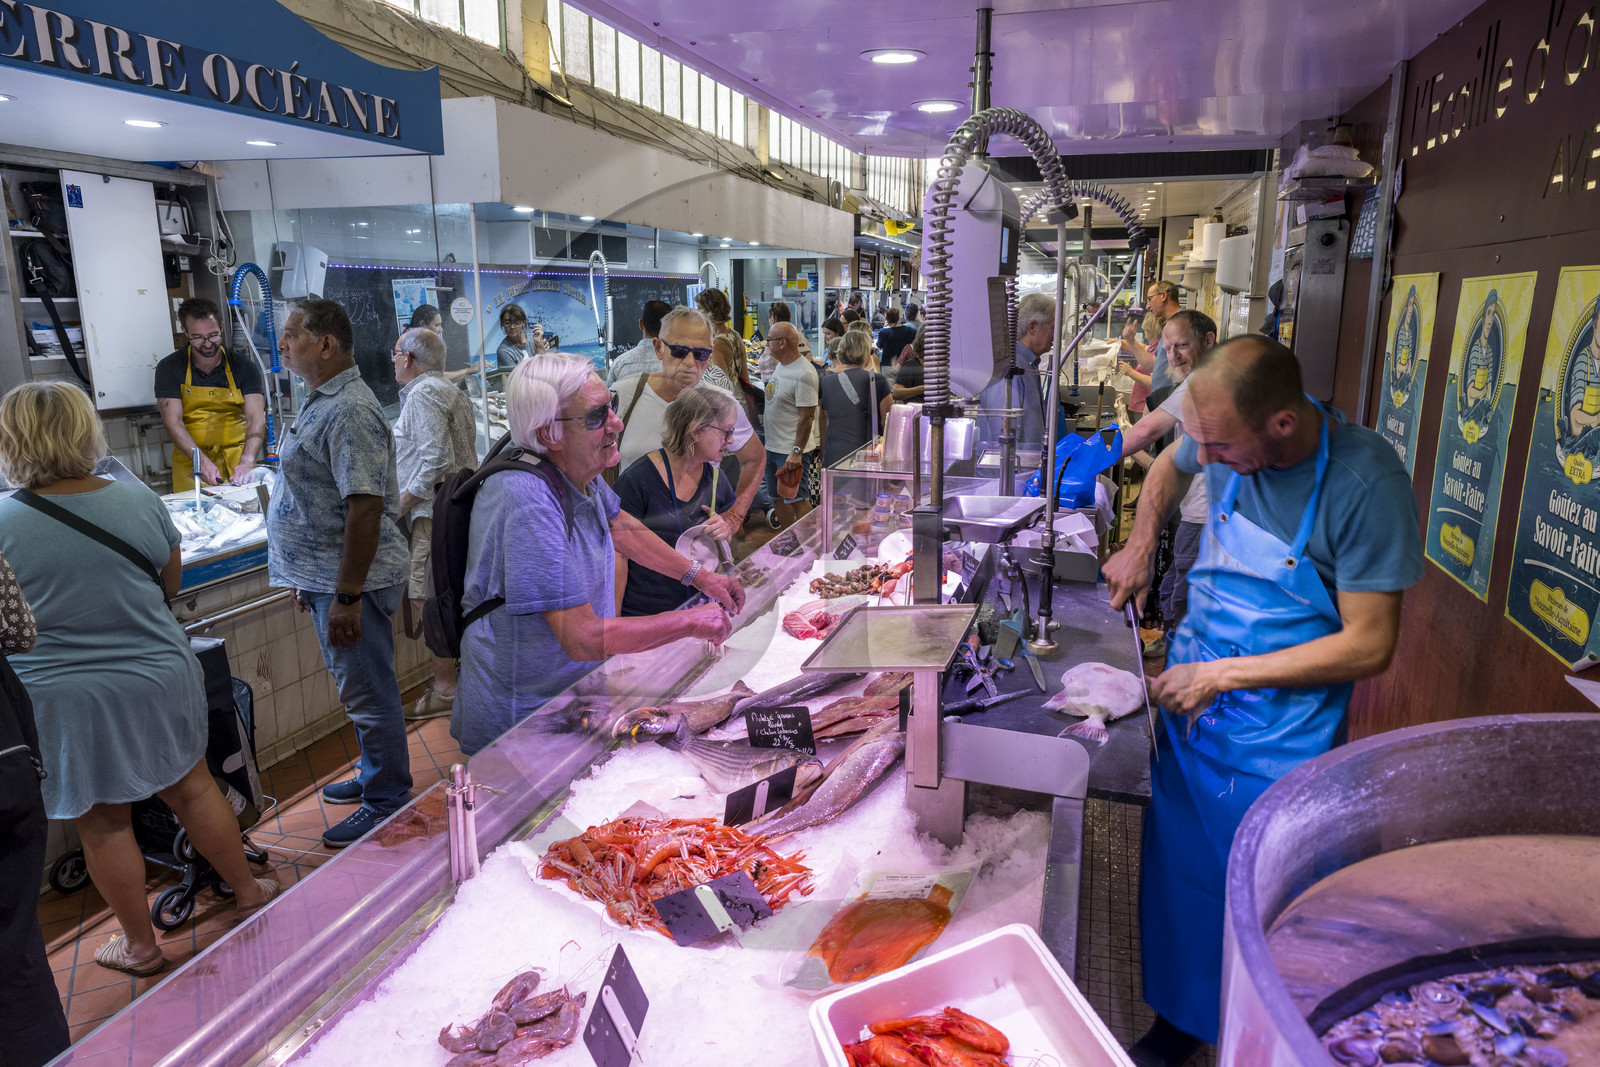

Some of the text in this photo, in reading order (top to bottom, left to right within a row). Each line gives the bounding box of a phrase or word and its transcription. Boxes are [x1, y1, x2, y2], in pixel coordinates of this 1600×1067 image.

[202, 53, 399, 138] OCÉANE
[1452, 449, 1482, 480] Goûtez au
[1569, 466, 1585, 480] EXTRA
[1442, 472, 1485, 514] Savoir-Faire
[1548, 489, 1598, 534] Goûtez au
